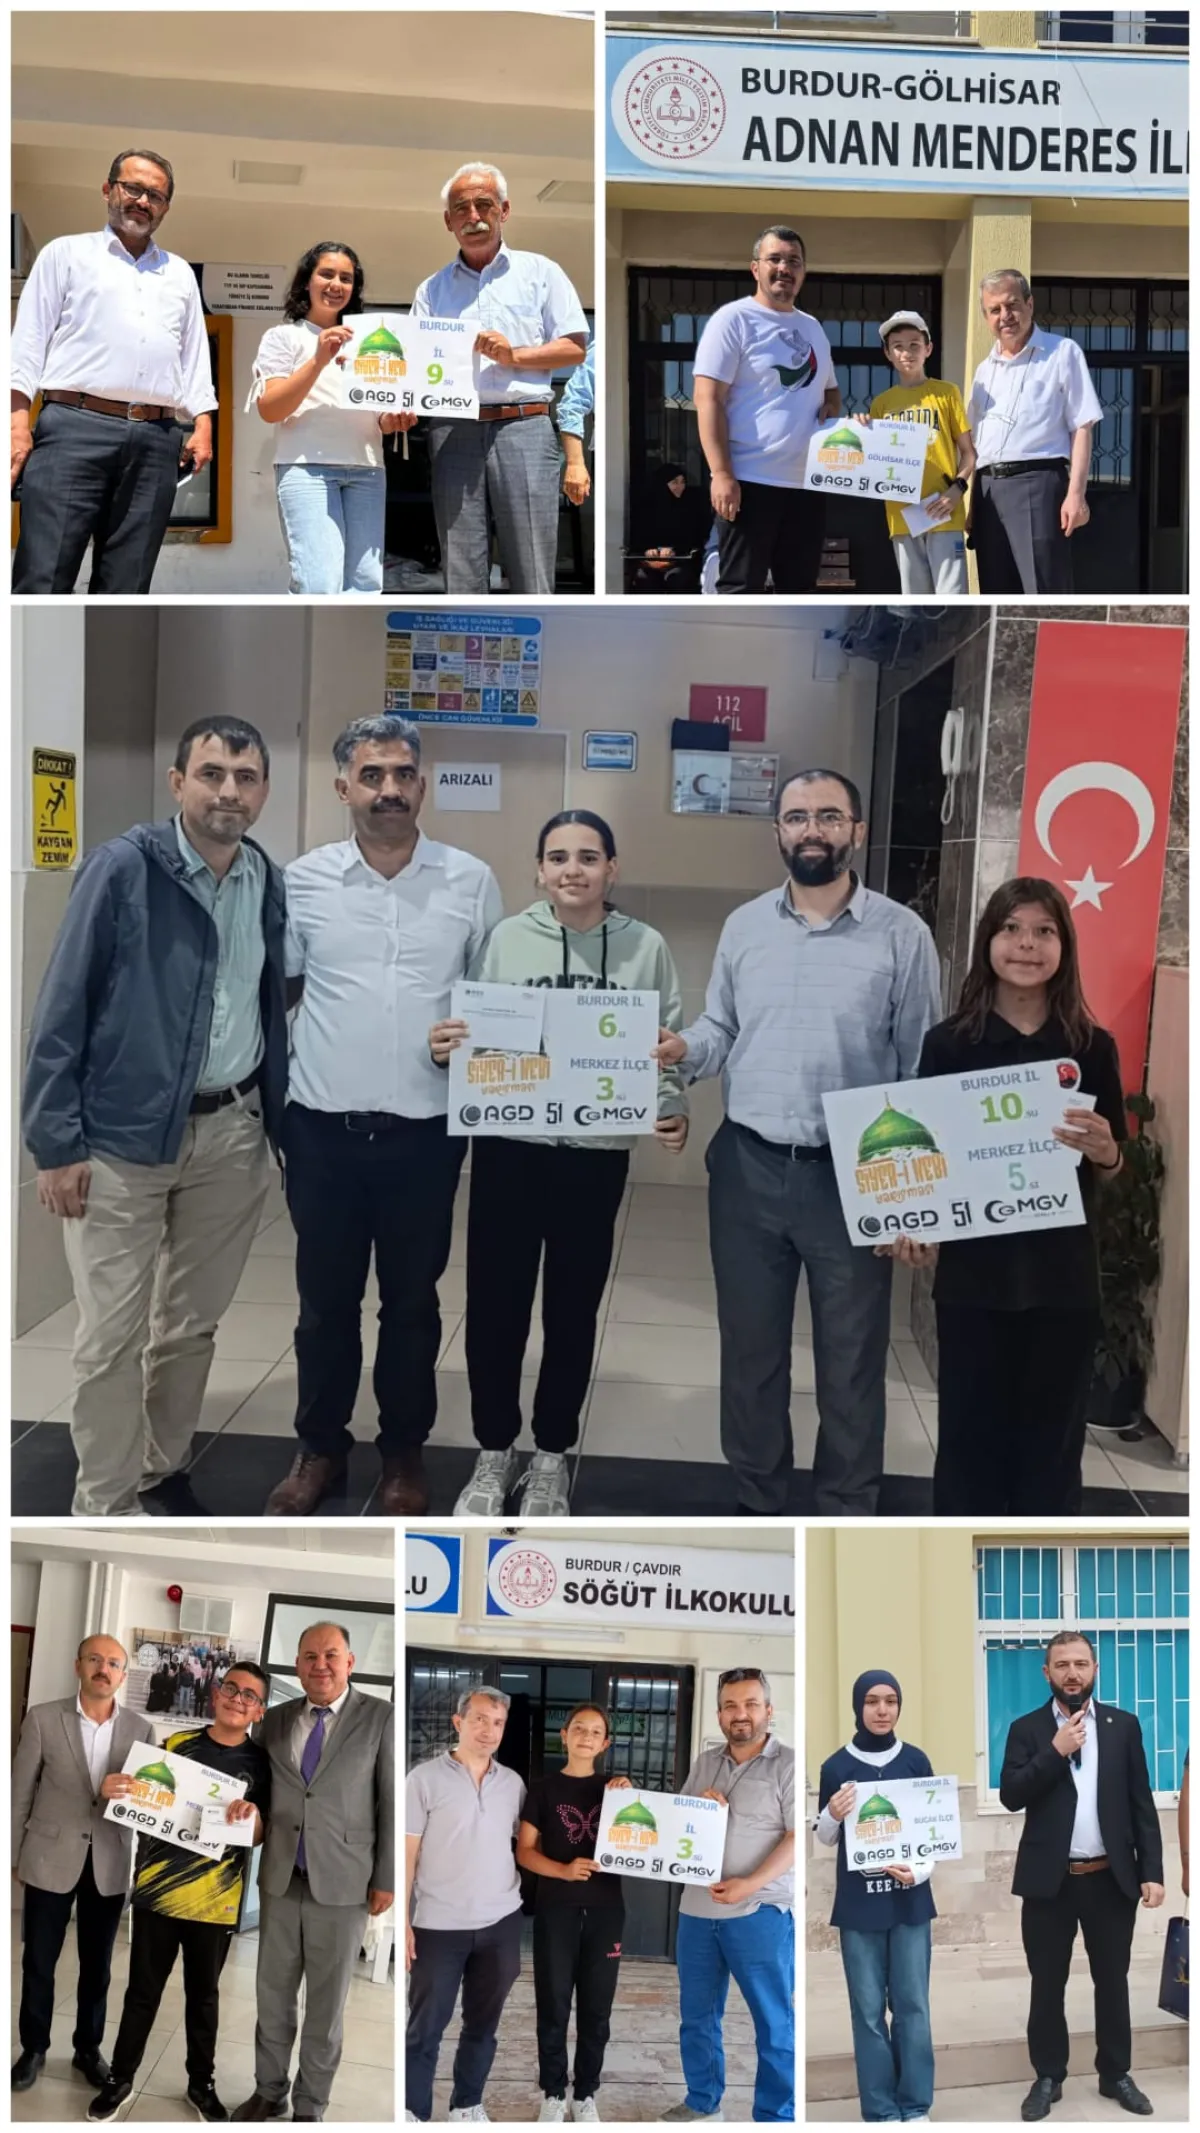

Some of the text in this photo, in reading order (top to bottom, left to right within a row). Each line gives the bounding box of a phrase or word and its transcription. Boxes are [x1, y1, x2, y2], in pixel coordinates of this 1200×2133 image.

[741, 67, 1061, 105] BURDUR-GÖLHİSAR
[742, 115, 1189, 174] ADNAN MENDERES İL
[419, 320, 465, 332] BURDUR
[433, 346, 445, 358] İL
[365, 390, 396, 403] AGD
[441, 397, 472, 407] MGV
[824, 475, 853, 487] AGD
[716, 695, 741, 712] 112
[440, 773, 493, 787] ARIZALI
[37, 836, 72, 848] KAYGAN
[577, 993, 645, 1007] BURDUR İL
[570, 1056, 651, 1072] MERKEZ İLÇE
[961, 1068, 1040, 1092] BURDUR İL
[484, 1105, 534, 1121] AGD
[603, 1107, 648, 1120] MGV
[968, 1138, 1061, 1162] MERKEZ İLÇE
[884, 1209, 939, 1232] AGD
[1016, 1193, 1068, 1213] MGV
[565, 1558, 621, 1574] BURDUR
[633, 1562, 682, 1578] ÇAVDIR
[563, 1578, 657, 1608] SÖĞÜT
[665, 1583, 795, 1617] İLKOKULU
[674, 1797, 718, 1812] BURDUR
[126, 1807, 157, 1827] AGD
[685, 1822, 696, 1834] İL
[867, 1848, 896, 1860] AGD
[615, 1855, 645, 1868] AGD
[687, 1865, 715, 1877] MGV
